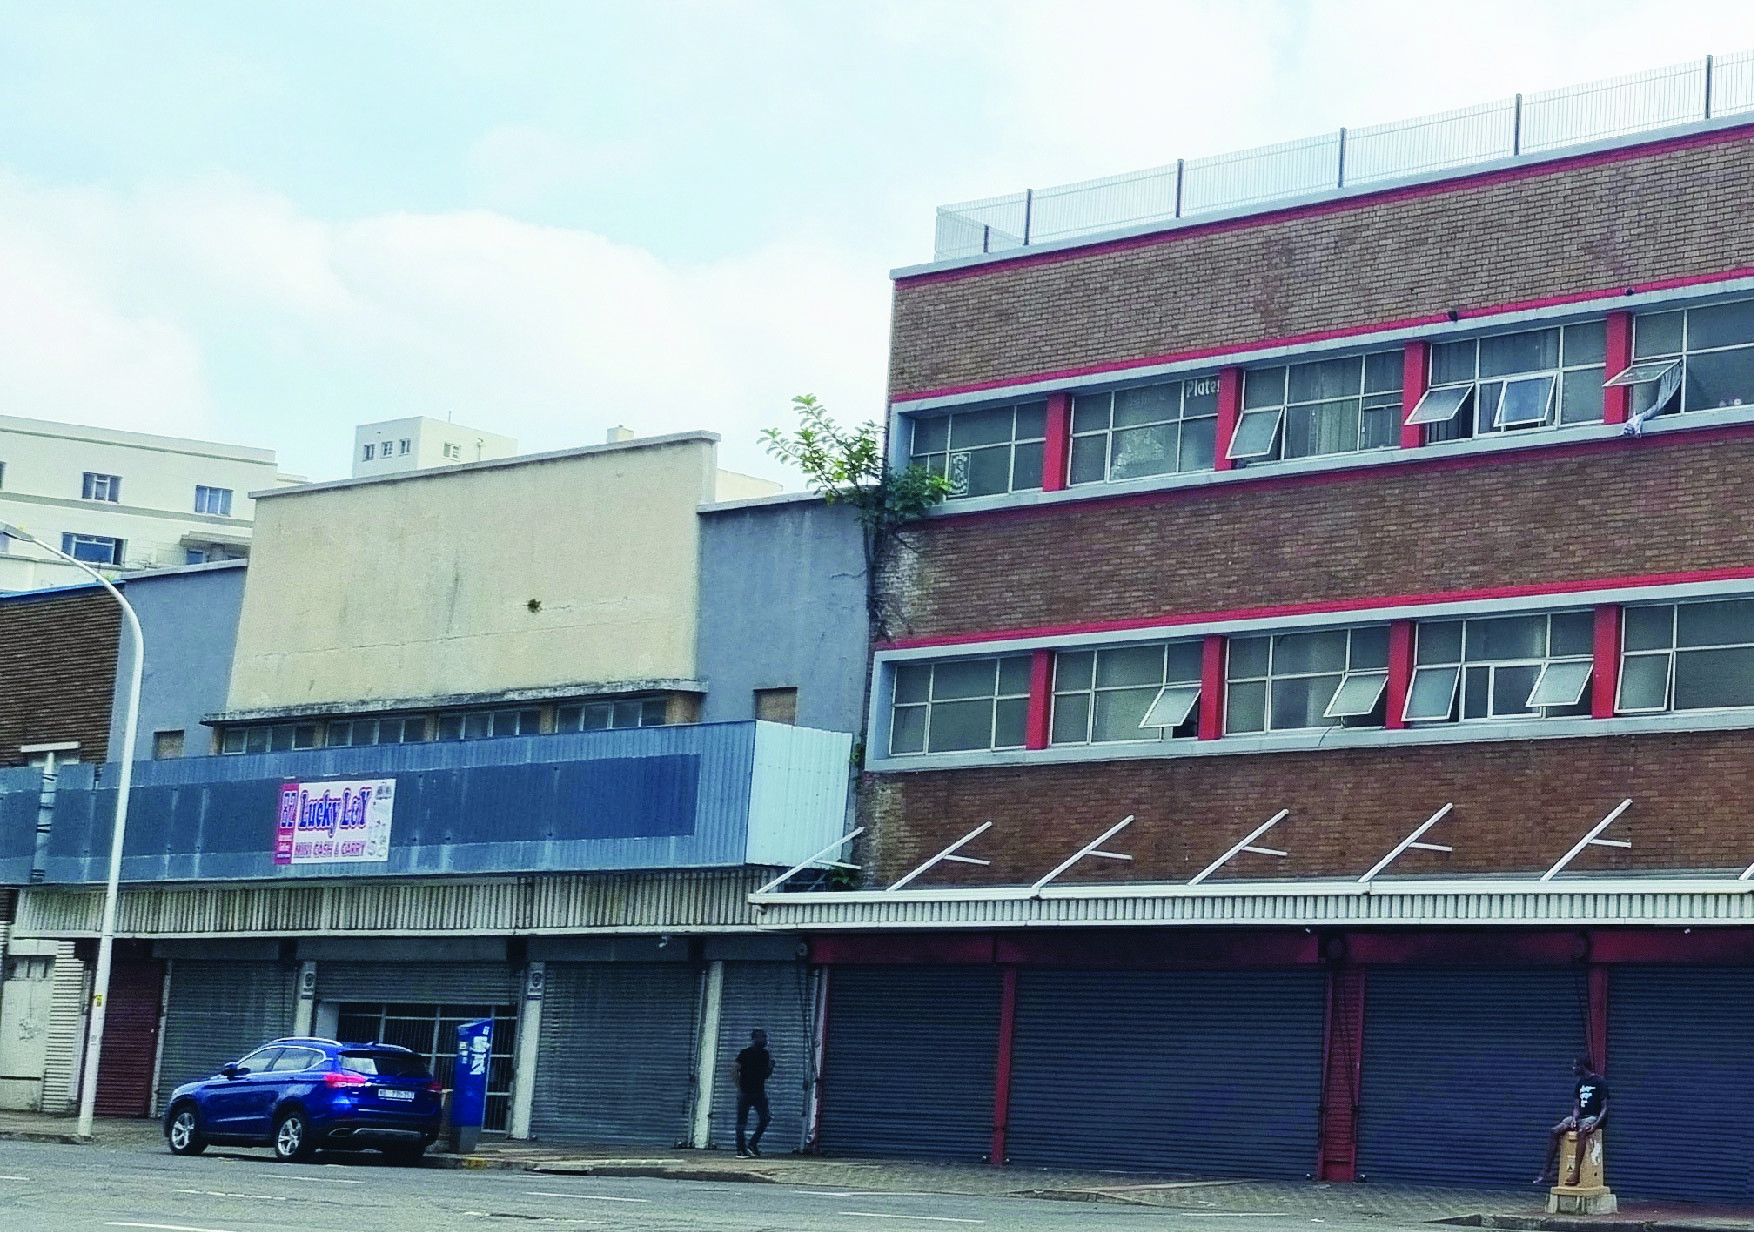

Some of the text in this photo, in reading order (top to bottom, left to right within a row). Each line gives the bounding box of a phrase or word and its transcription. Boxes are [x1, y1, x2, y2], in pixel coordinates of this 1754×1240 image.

[298, 789, 341, 838] Lucky
[313, 841, 334, 858] CASH
[341, 841, 366, 857] CARRY
